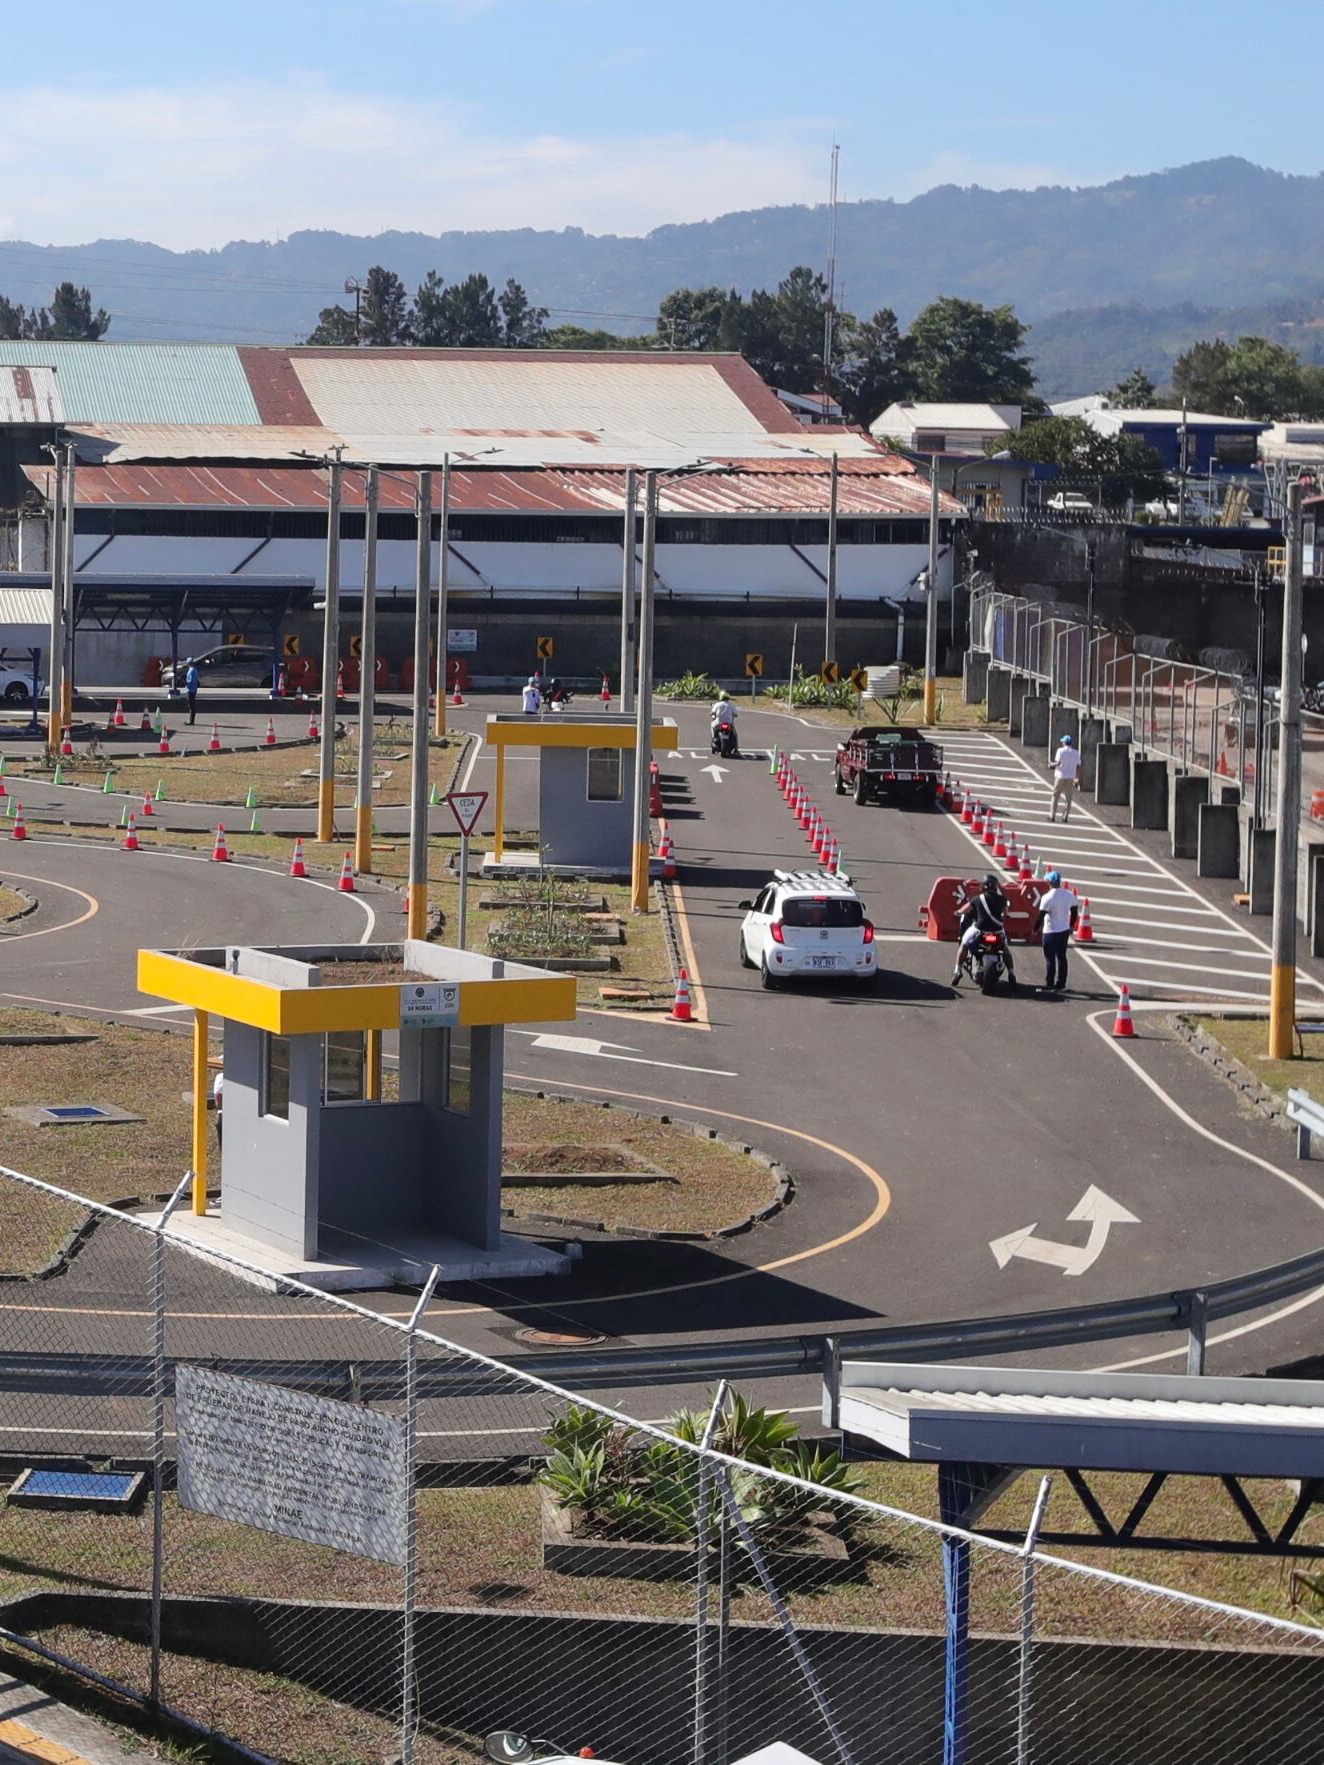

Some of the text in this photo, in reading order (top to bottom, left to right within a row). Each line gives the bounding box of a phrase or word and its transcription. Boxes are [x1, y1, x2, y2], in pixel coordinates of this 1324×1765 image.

[460, 799, 475, 807] CEDA
[186, 1392, 194, 1401] DE
[197, 1394, 231, 1410] PRUEBAS
[233, 1403, 243, 1413] DE
[245, 1406, 275, 1421] MANEJO
[278, 1414, 286, 1423] DE
[290, 1417, 309, 1429] PASO
[312, 1422, 338, 1436] ANCHO
[241, 1394, 265, 1408] ETAPA
[334, 1416, 349, 1428] DEL
[351, 1421, 383, 1436] CENTRO
[274, 1503, 302, 1520] MINAE
